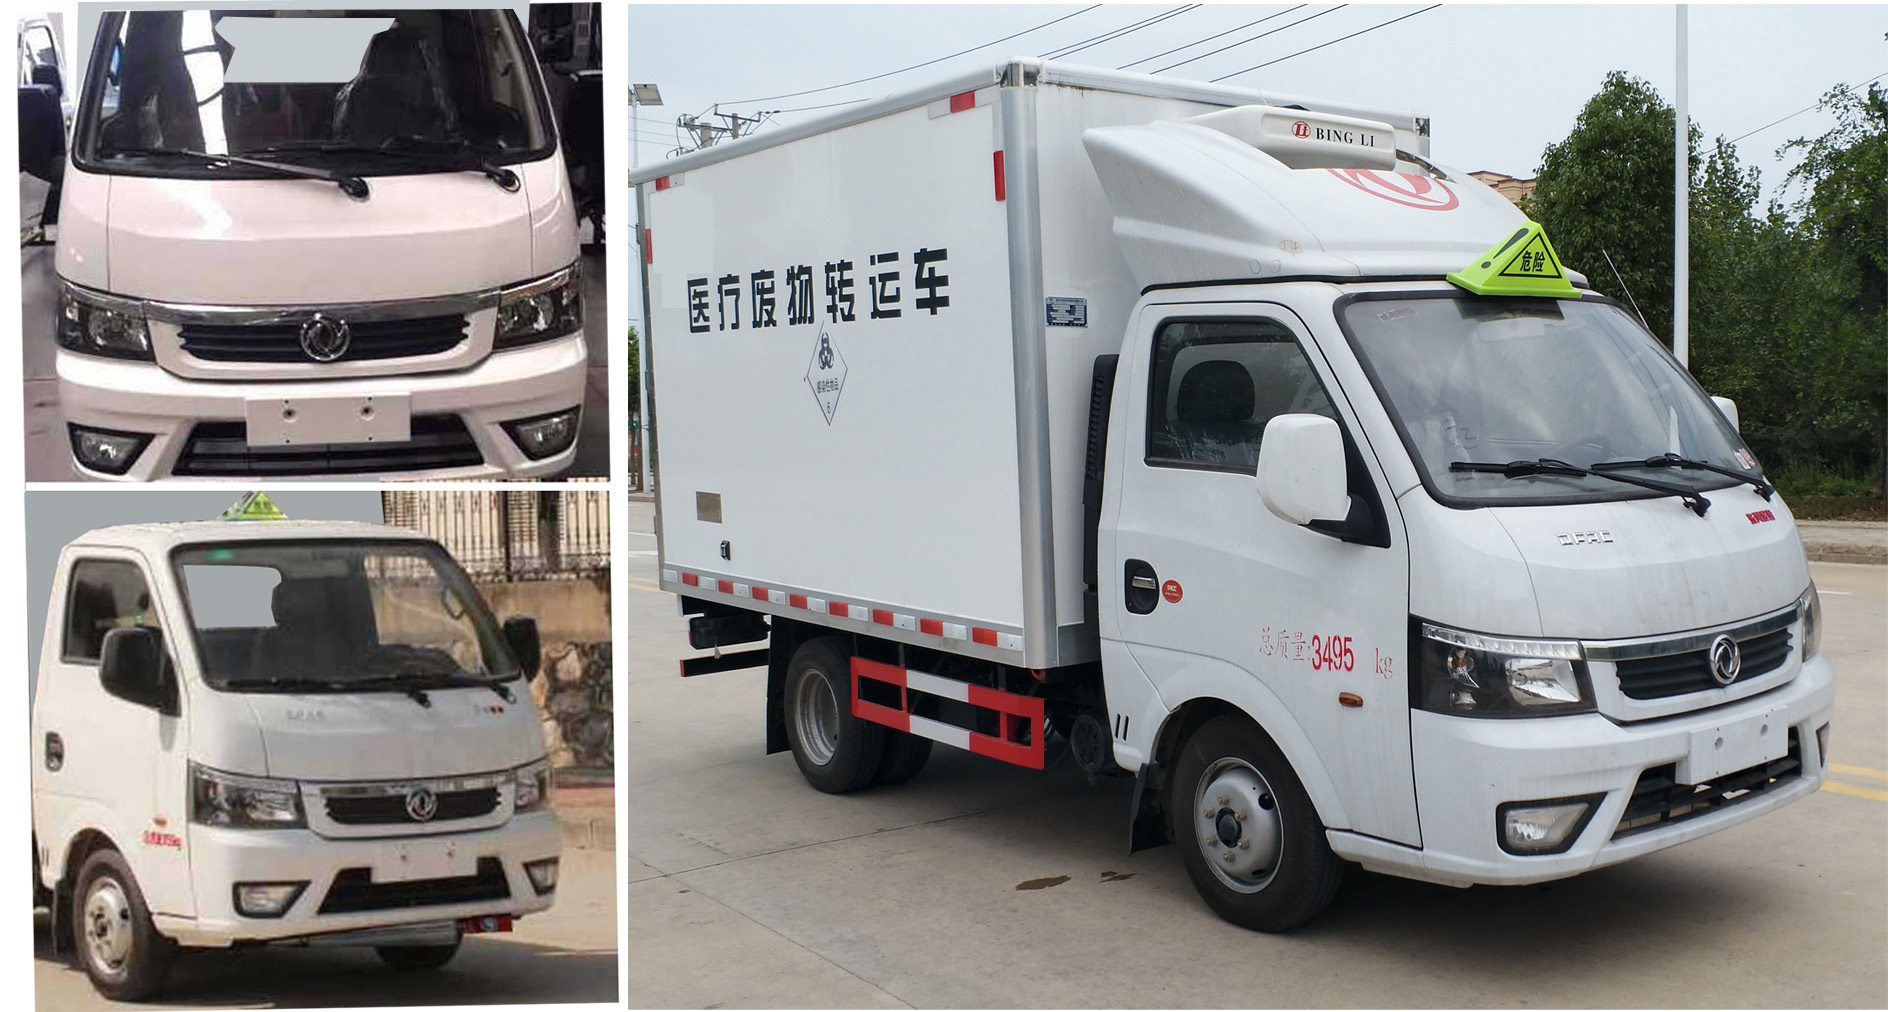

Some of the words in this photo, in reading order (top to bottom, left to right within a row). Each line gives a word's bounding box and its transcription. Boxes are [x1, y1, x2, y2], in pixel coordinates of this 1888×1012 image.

[1316, 127, 1353, 144] BING
[1361, 133, 1374, 147] LI
[1520, 250, 1545, 272] 危险
[688, 248, 950, 333] 医疗废物转运车
[1375, 647, 1393, 680] kg
